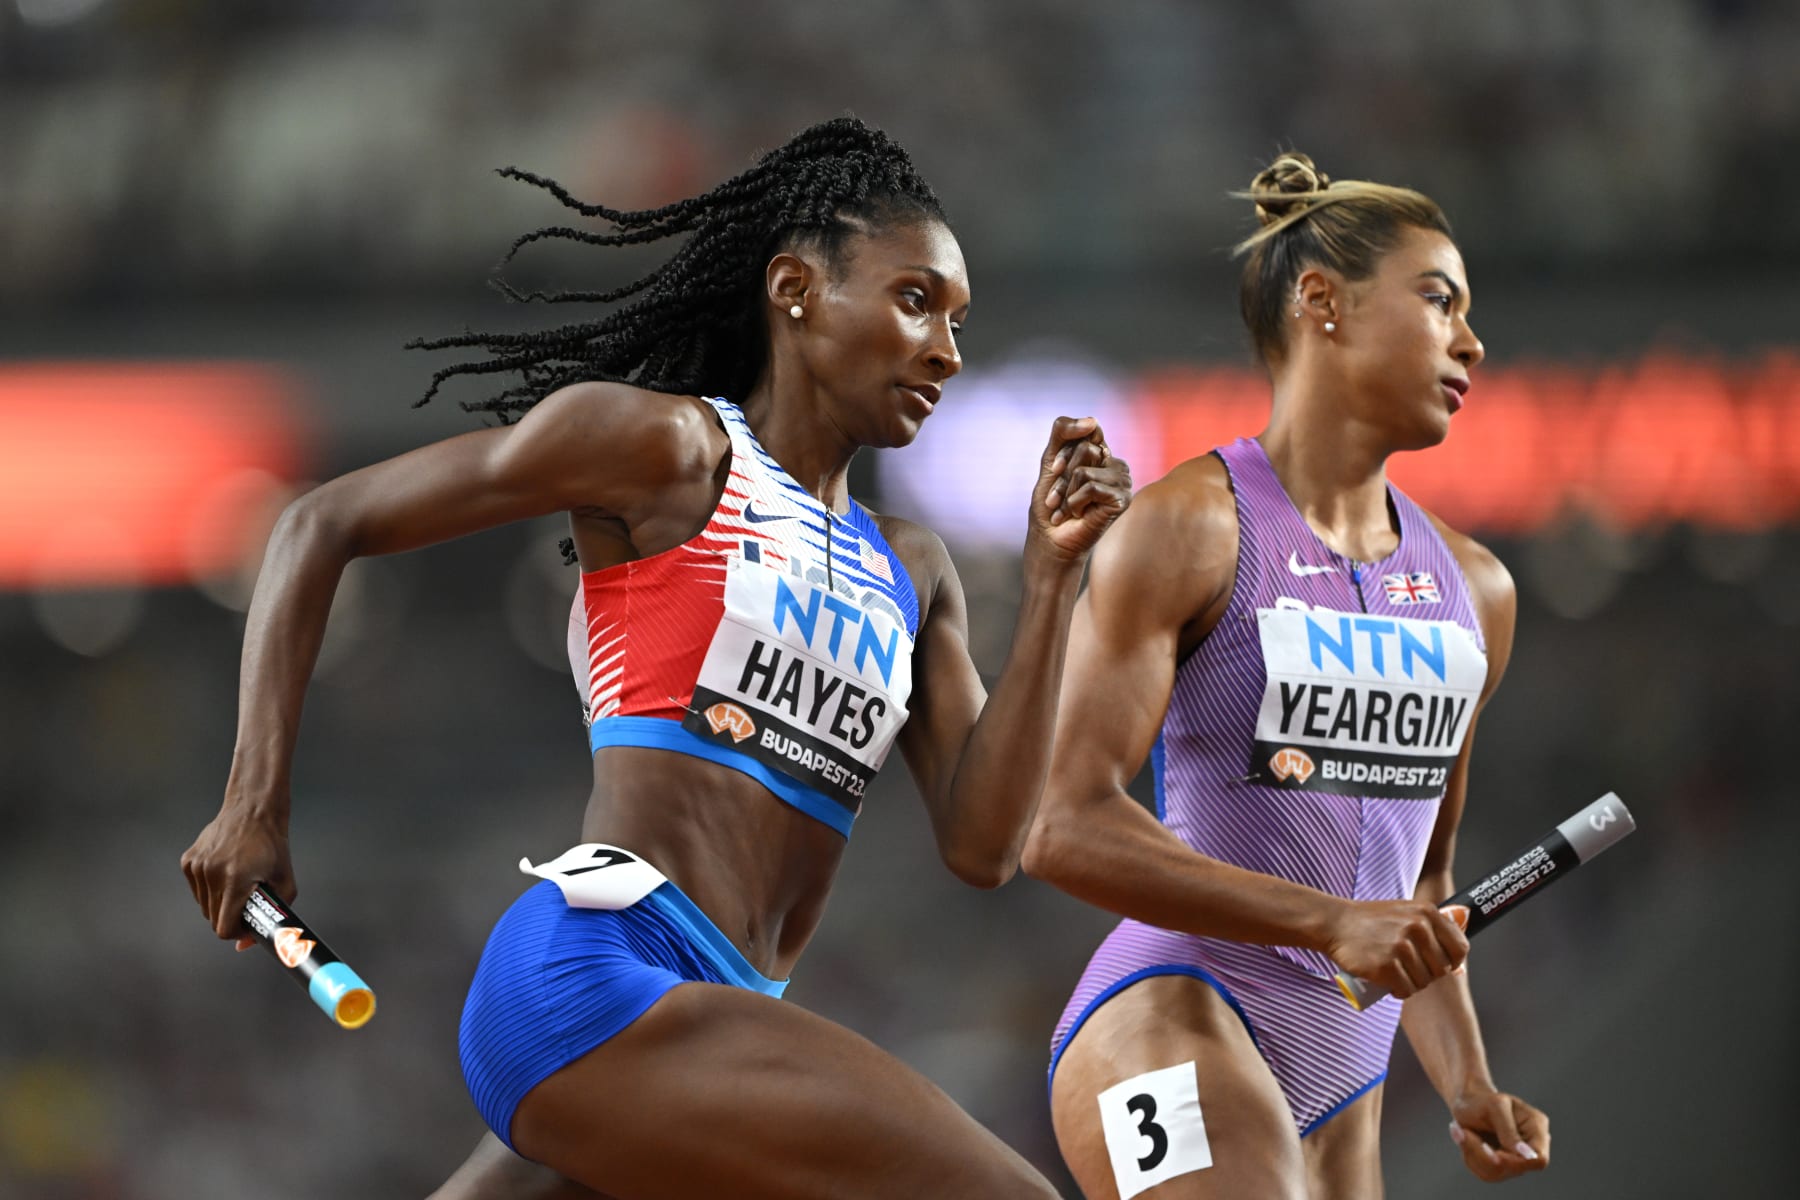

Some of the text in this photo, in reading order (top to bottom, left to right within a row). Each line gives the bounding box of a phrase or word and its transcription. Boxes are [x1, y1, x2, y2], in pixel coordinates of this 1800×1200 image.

[773, 575, 899, 689] NTN
[1305, 616, 1446, 683] NTN
[737, 640, 886, 750] HAYES
[1279, 682, 1467, 748] YEARGIN
[760, 727, 851, 785] BUDAPEST
[1321, 760, 1447, 786] BUDAPEST 23
[560, 849, 637, 876] 7
[1467, 845, 1545, 898] WORLD ATHLETICS
[1473, 852, 1550, 906] CHAMPIONSHIPS
[1480, 860, 1556, 915] BUDAPEST 23
[250, 890, 285, 923] BUDAPES
[1126, 1093, 1168, 1172] 3
